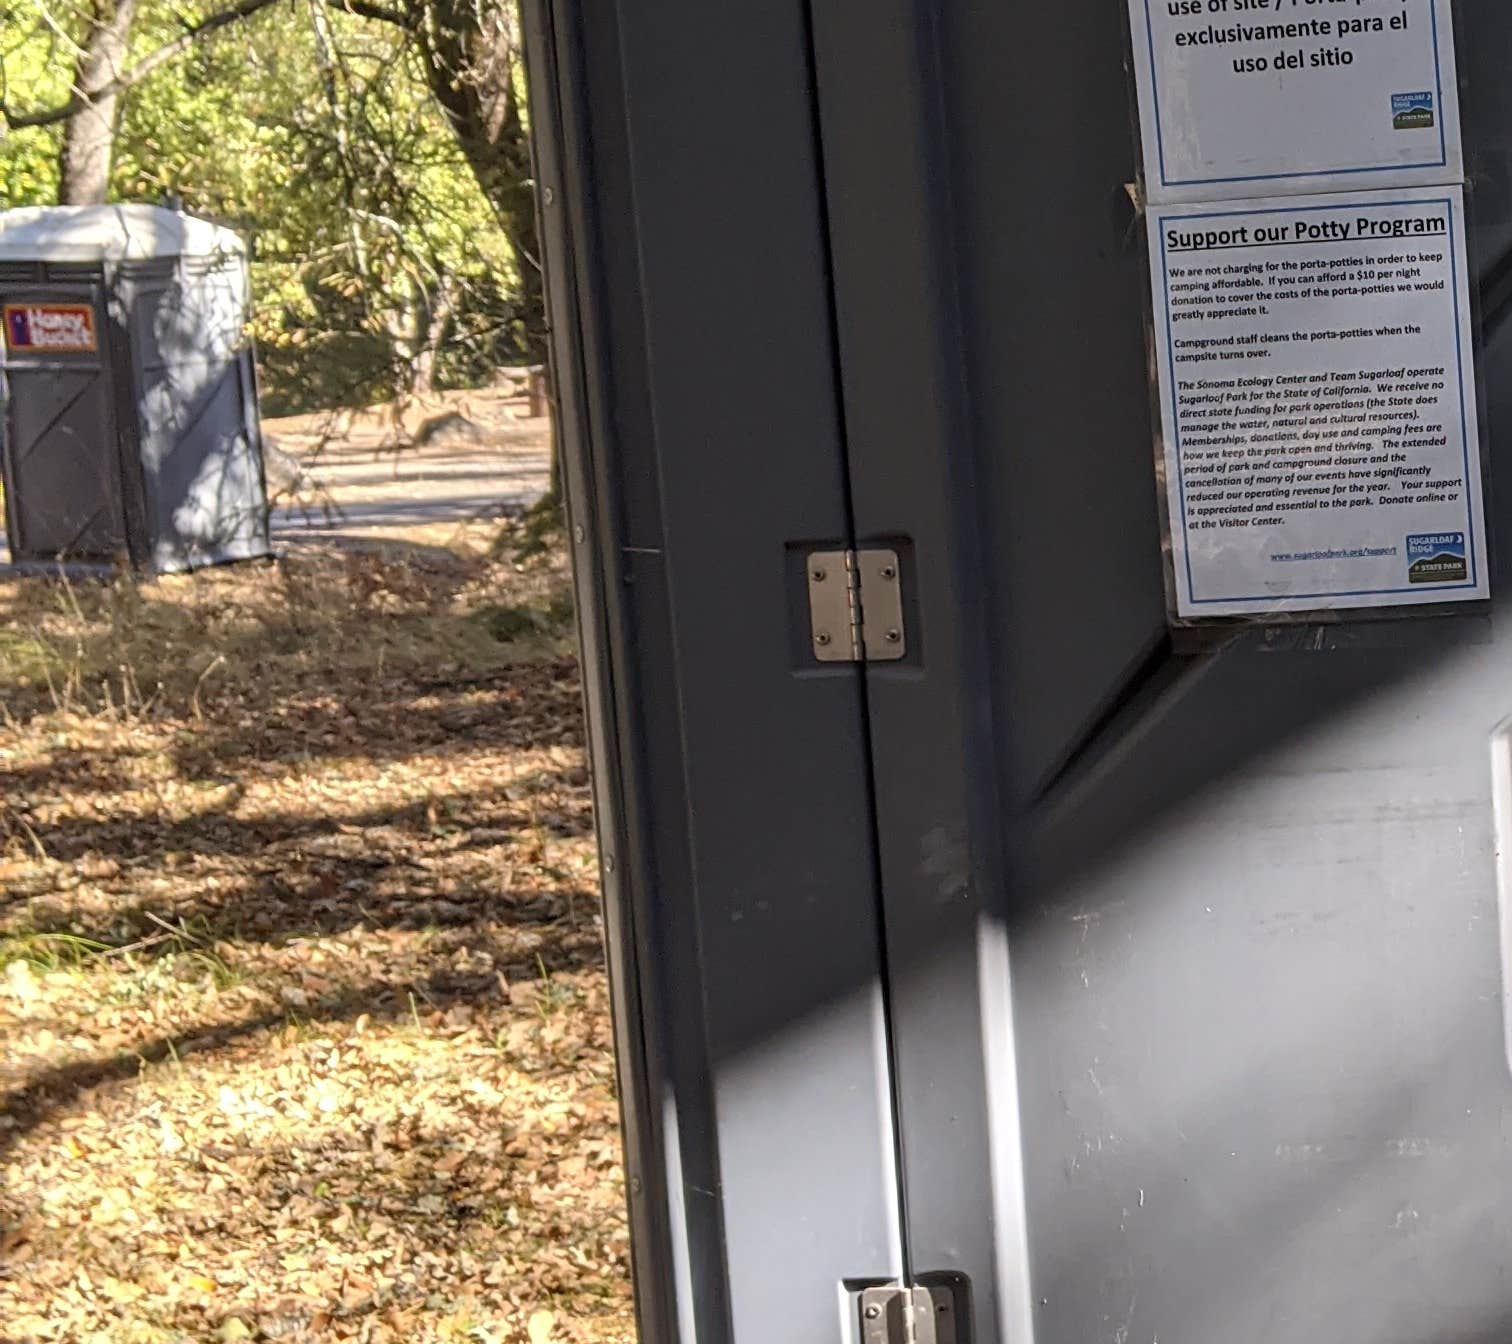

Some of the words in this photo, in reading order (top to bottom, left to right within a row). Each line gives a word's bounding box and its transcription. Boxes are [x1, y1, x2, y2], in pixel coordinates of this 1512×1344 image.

[1167, 0, 1202, 16] use
[1175, 19, 1331, 46] exclusivamente
[1337, 17, 1383, 37] para
[1389, 10, 1407, 30] el
[1232, 57, 1268, 73] uso
[1273, 49, 1304, 70] del
[1310, 47, 1353, 67] sitio
[1167, 226, 1248, 249] Support
[1253, 226, 1289, 242] our
[1294, 220, 1350, 240] Potty
[1356, 217, 1445, 237] Program
[1167, 268, 1186, 277] We
[1186, 268, 1204, 276] are
[1203, 266, 1222, 275] not
[1221, 263, 1265, 275] charging
[1264, 261, 1280, 271] for
[1280, 260, 1299, 270] the
[1299, 256, 1365, 271] porta-potties
[1364, 255, 1376, 265] in
[1376, 254, 1405, 264] order
[1404, 254, 1418, 263] to
[1417, 252, 1444, 263] keep
[1168, 281, 1211, 292] camping
[1267, 275, 1276, 285] If
[1276, 276, 1297, 287] you
[1296, 275, 1316, 284] can
[1315, 271, 1347, 283] afford
[1347, 272, 1356, 280] a
[1355, 269, 1376, 281] $10
[1376, 271, 1394, 281] per
[1394, 267, 1422, 279] night
[1169, 295, 1214, 306] donation
[1214, 295, 1227, 303] to
[1226, 293, 1255, 303] cover
[1254, 291, 1273, 300] the
[1273, 290, 1300, 299] costs
[1299, 287, 1312, 298] of
[1311, 287, 1330, 297] the
[1330, 283, 1396, 297] porta-potties
[1395, 283, 1413, 292] we
[1412, 279, 1445, 290] would
[1171, 309, 1206, 322] greatly
[1205, 306, 1258, 319] appreciate
[1172, 335, 1235, 349] Campground
[1235, 333, 1259, 345] staff
[1258, 333, 1291, 343] cleans
[1290, 331, 1309, 341] the
[1309, 327, 1374, 342] porta-potties
[1373, 326, 1403, 336] when
[1403, 324, 1422, 334] the
[1173, 351, 1218, 363] campsite
[1218, 351, 1246, 360] turns
